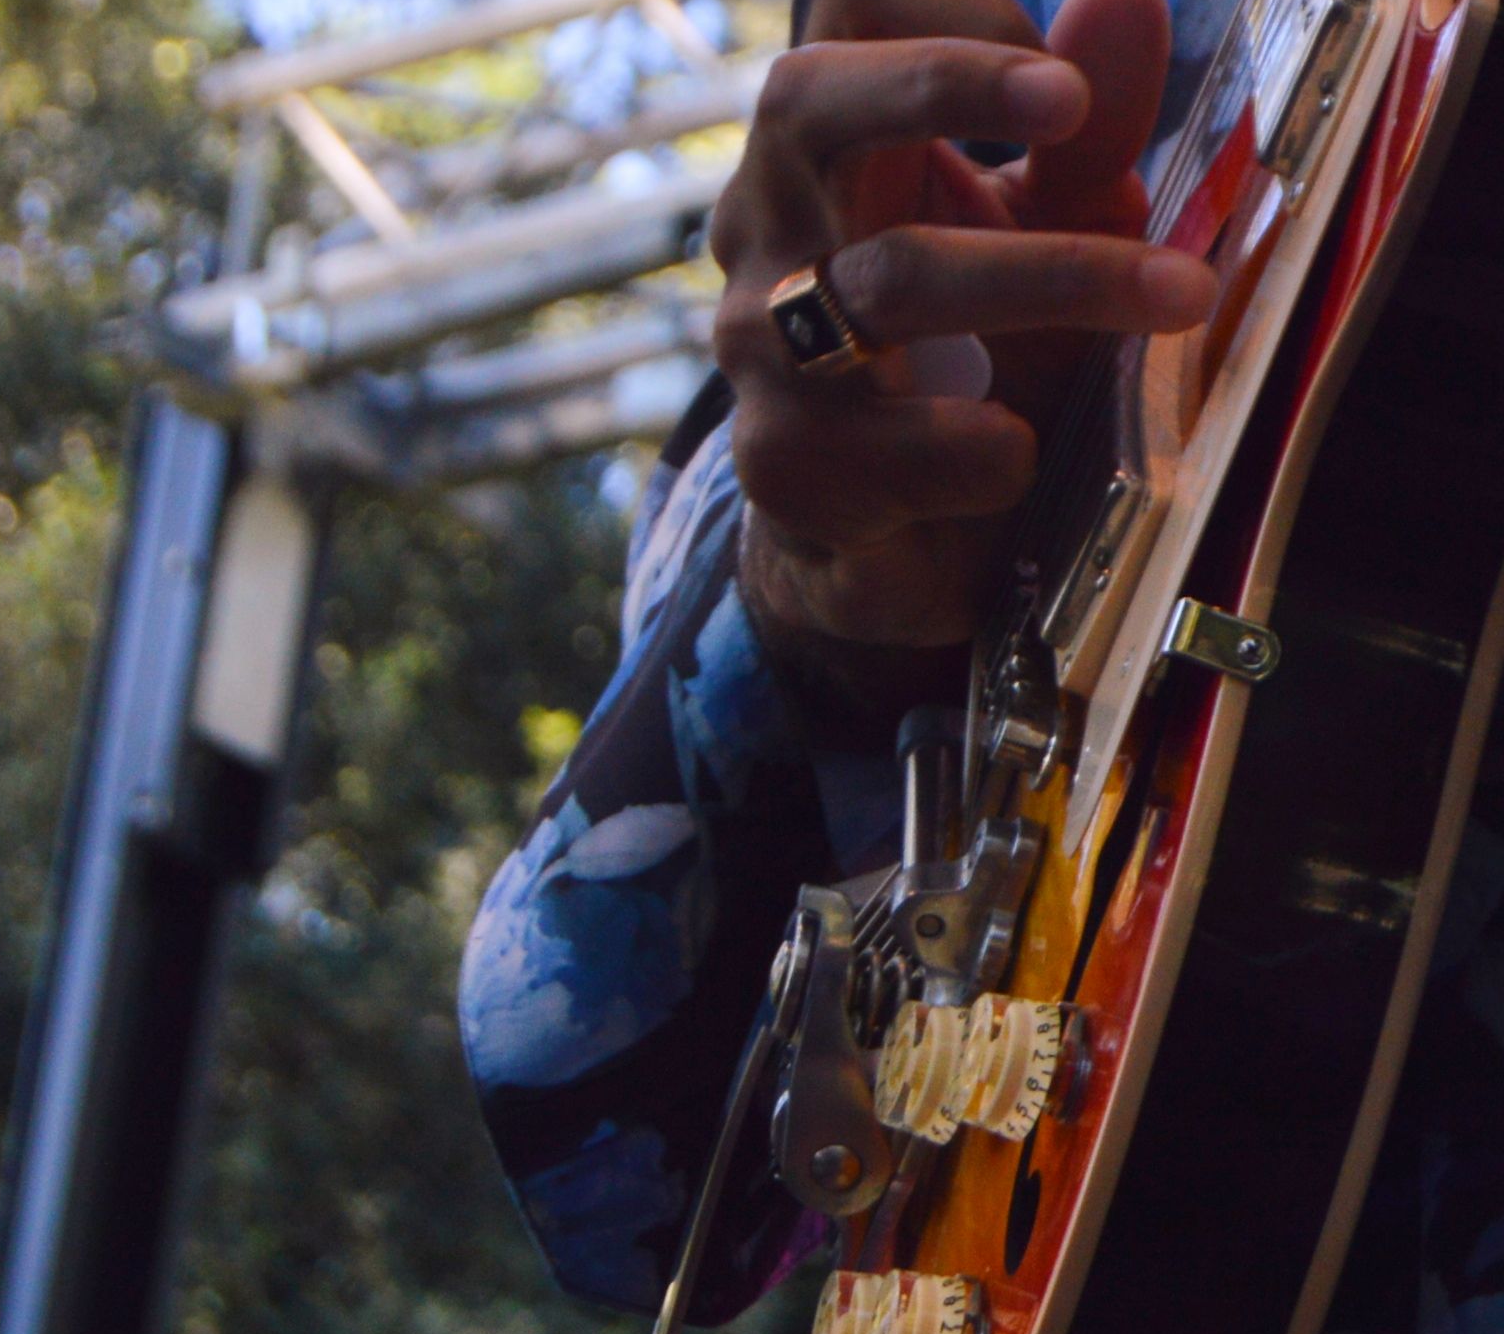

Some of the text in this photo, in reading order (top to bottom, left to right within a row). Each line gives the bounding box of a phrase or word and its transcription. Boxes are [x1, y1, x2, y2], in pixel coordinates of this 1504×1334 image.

[1036, 1023, 1051, 1035] 8
[1033, 1048, 1046, 1062] 7
[1026, 1076, 1039, 1091] 6
[1015, 1101, 1029, 1117] 5
[940, 1320, 953, 1334] 7
